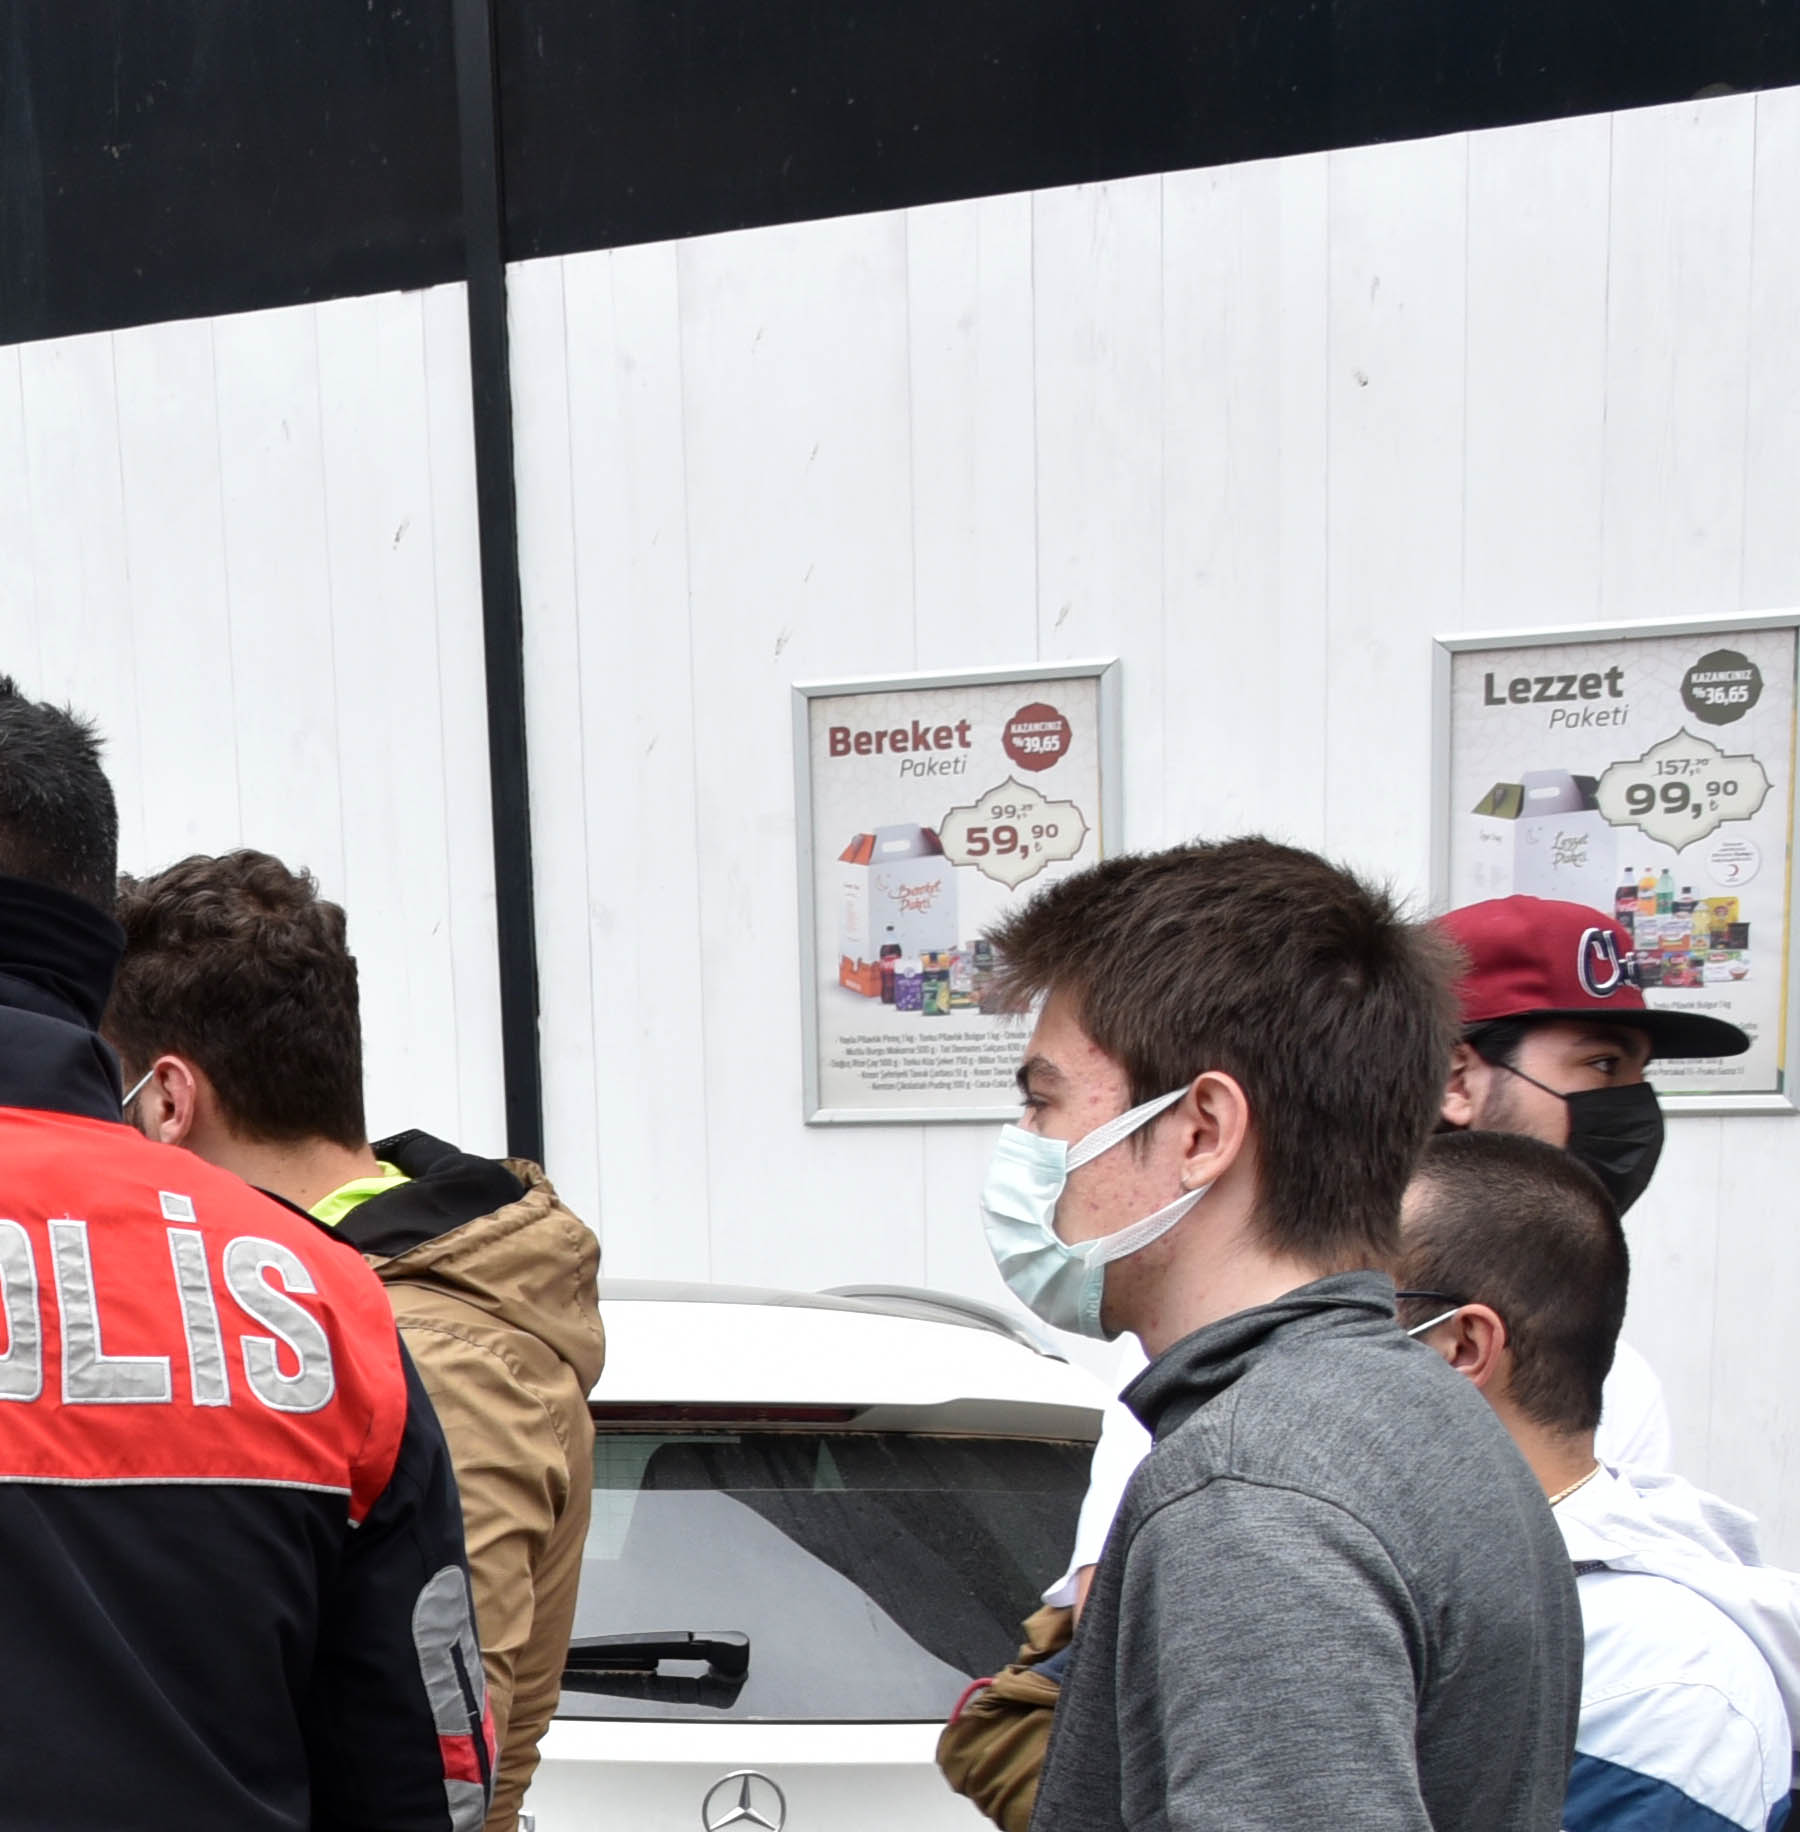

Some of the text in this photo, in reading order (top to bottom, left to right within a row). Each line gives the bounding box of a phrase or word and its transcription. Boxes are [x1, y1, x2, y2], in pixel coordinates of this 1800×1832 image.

[1483, 665, 1625, 706] Lezzet
[1549, 704, 1630, 730] Paketi
[828, 718, 972, 757] Bereket
[899, 754, 968, 778] Paketi
